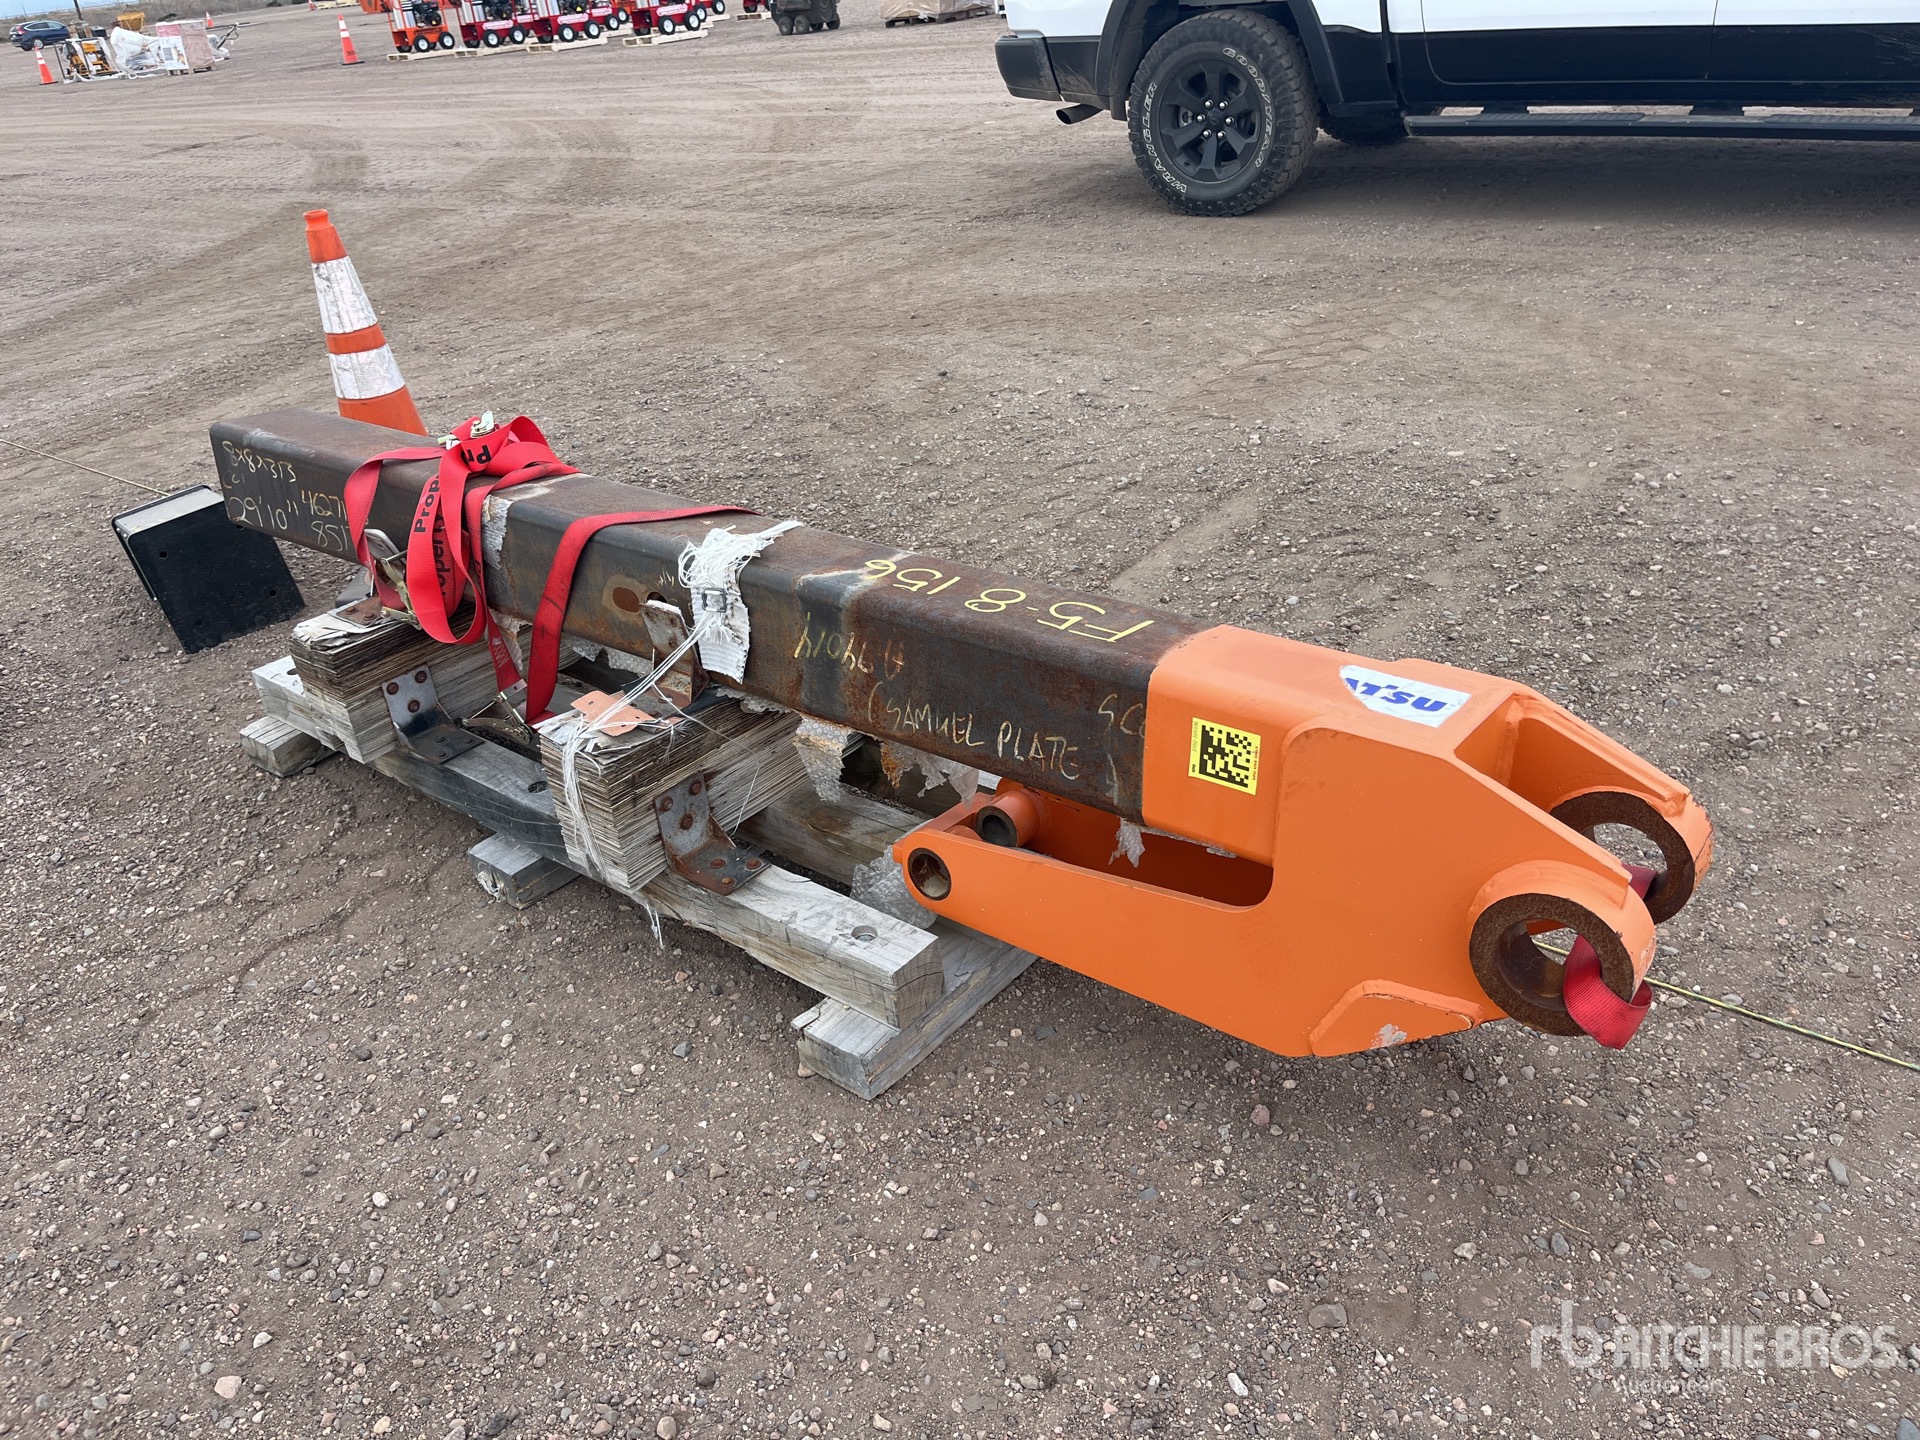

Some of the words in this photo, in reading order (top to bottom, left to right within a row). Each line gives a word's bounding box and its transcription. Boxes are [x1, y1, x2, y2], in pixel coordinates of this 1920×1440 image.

[1142, 81, 1188, 194] WRANGLER
[1222, 47, 1274, 168] GOODYEAR
[413, 474, 440, 533] Prop
[997, 720, 1080, 781] PLATE
